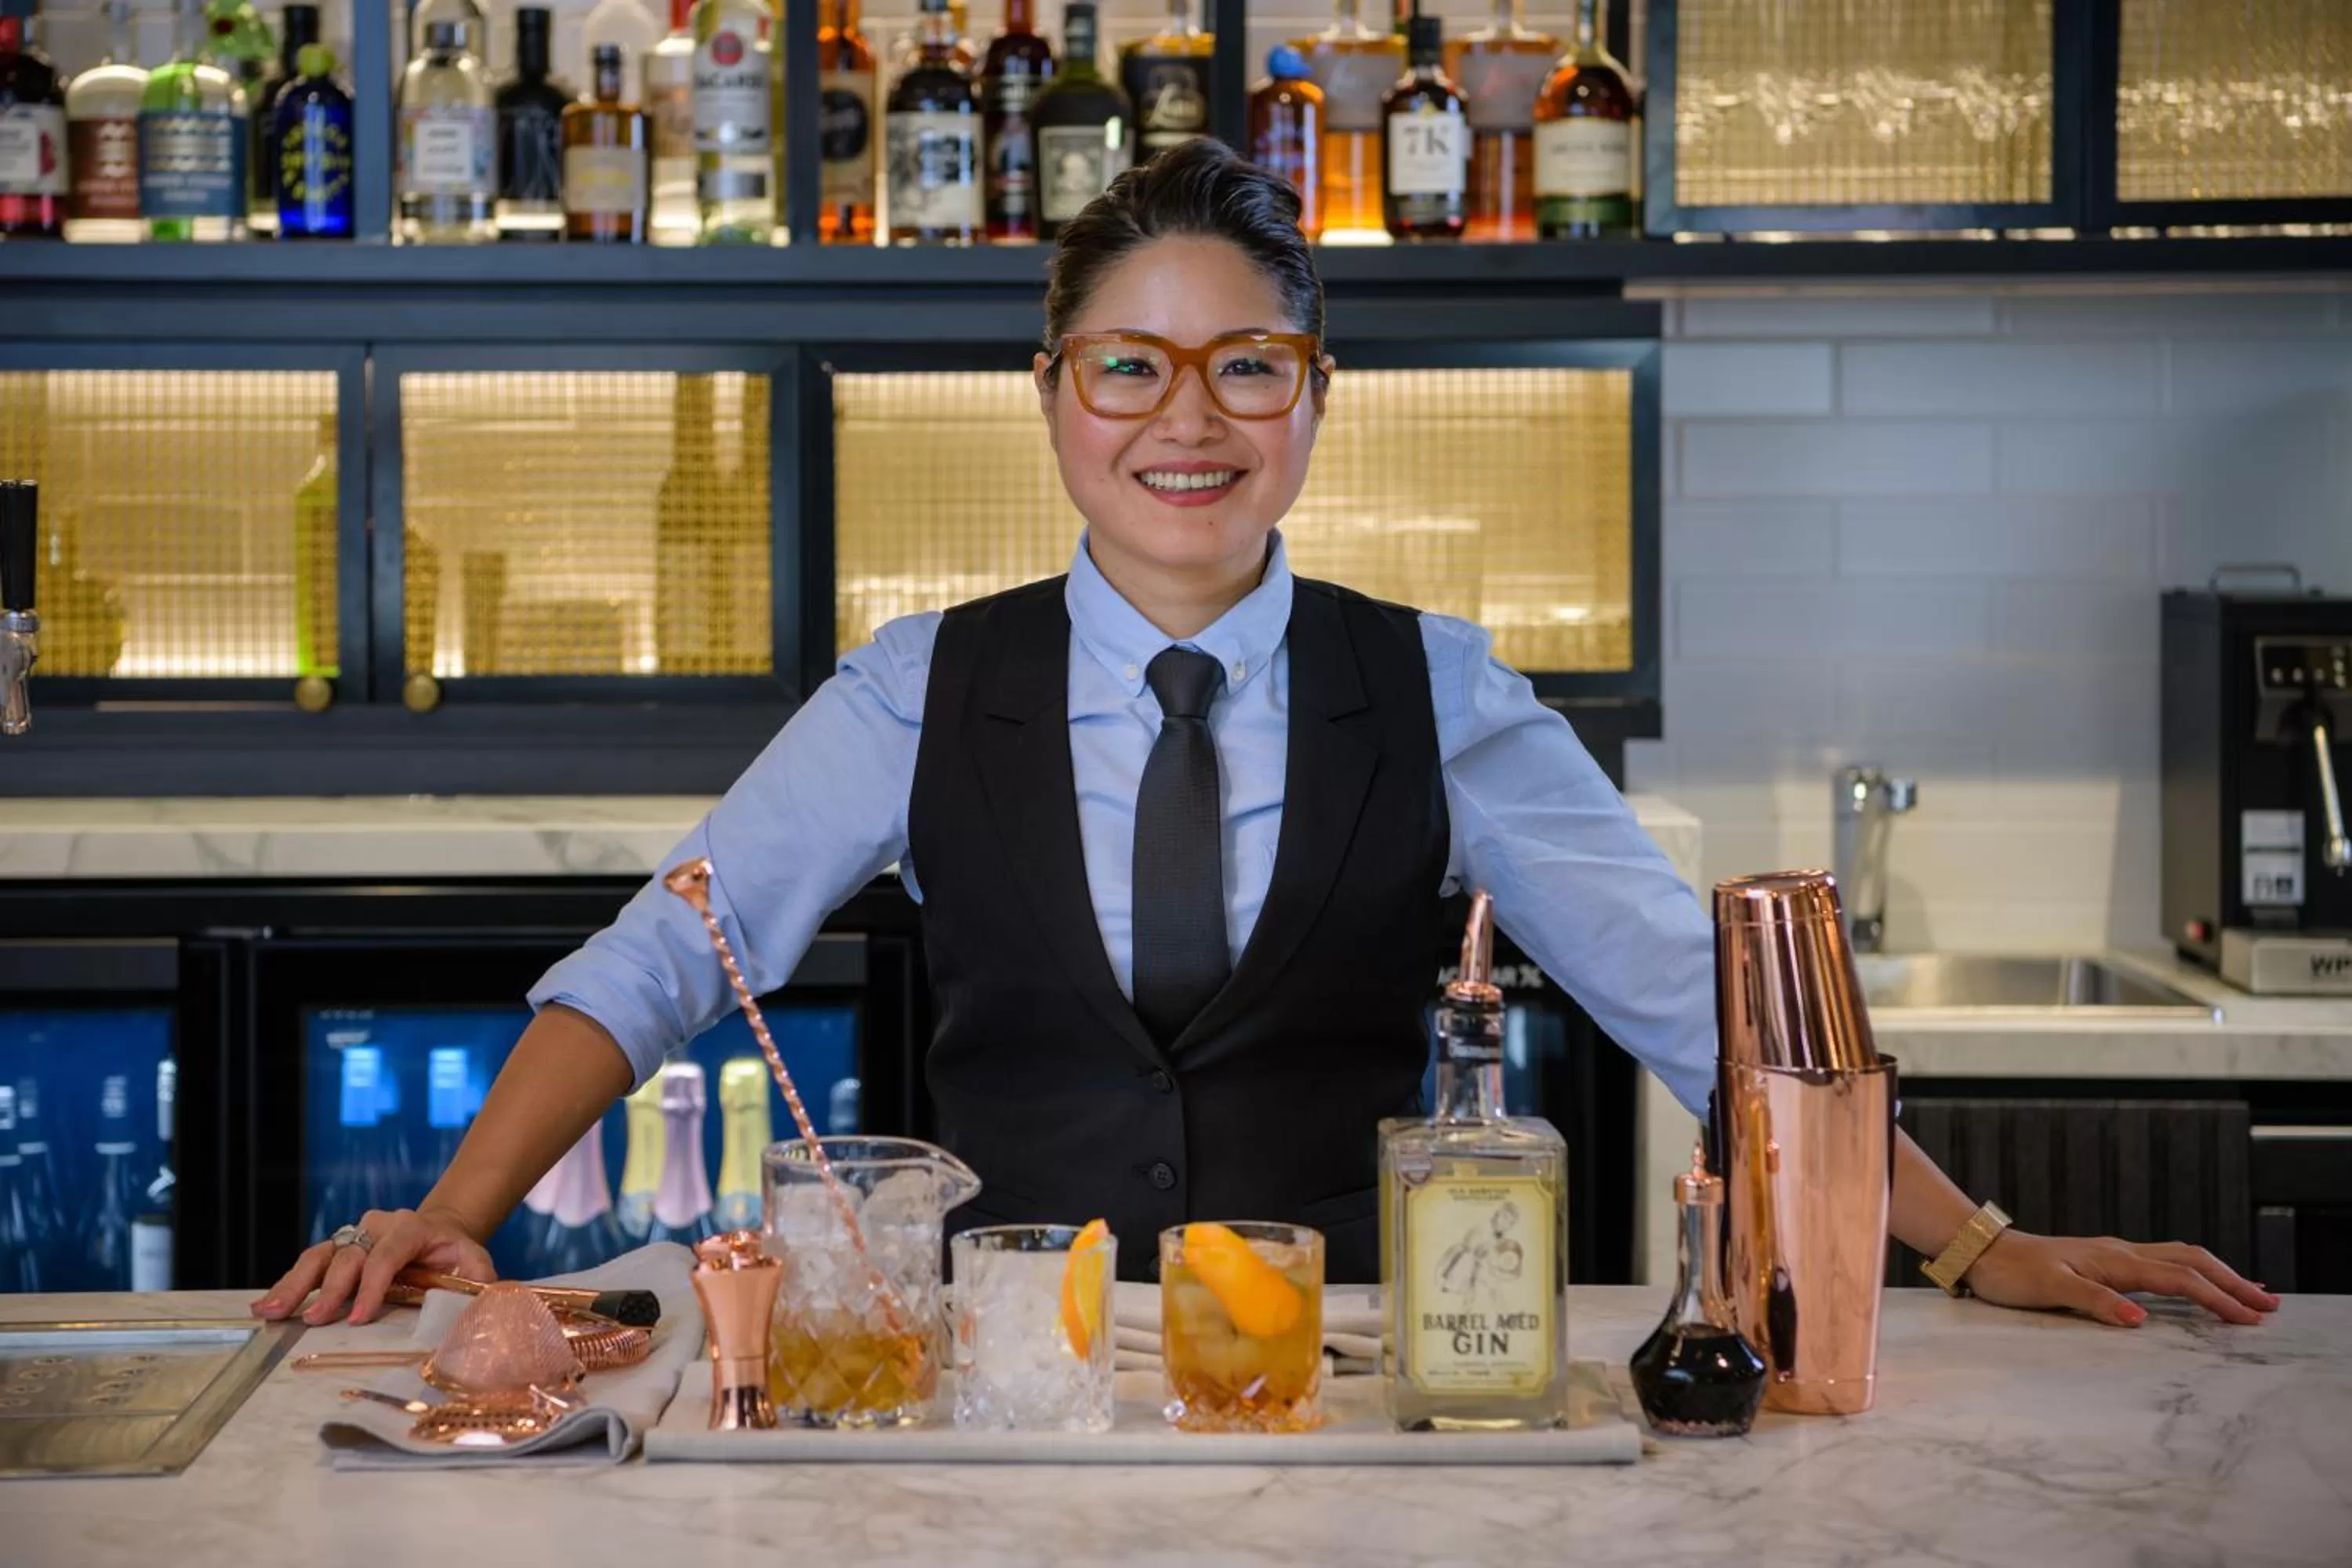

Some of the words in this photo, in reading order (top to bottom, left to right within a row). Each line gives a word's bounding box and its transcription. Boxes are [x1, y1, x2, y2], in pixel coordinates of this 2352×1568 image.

[1423, 1314, 1489, 1333] BARREL
[1496, 1312, 1541, 1331] AGED
[1453, 1333, 1509, 1356] GIN
